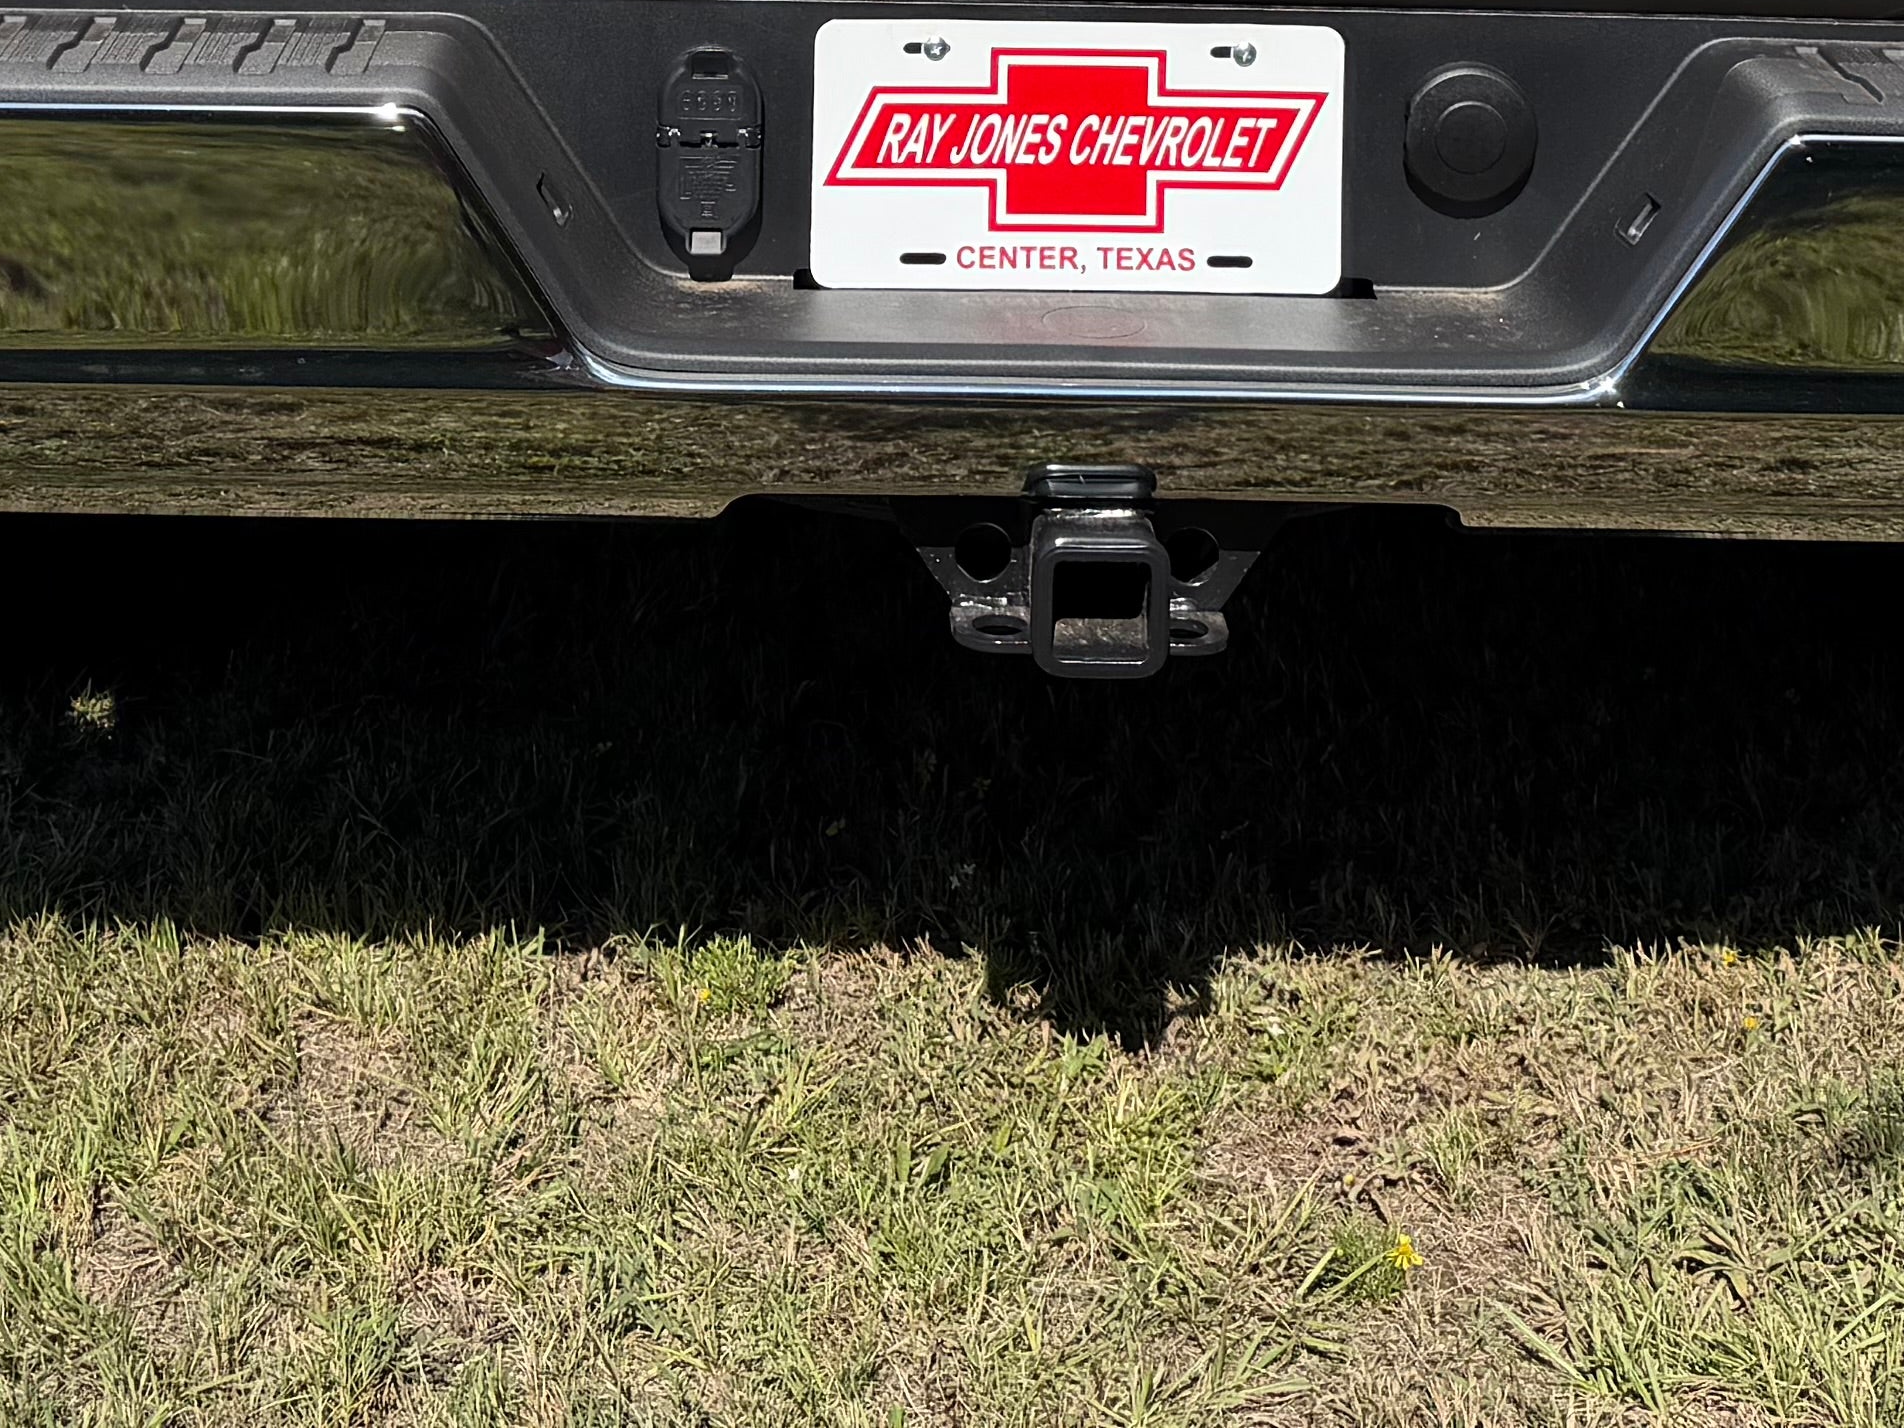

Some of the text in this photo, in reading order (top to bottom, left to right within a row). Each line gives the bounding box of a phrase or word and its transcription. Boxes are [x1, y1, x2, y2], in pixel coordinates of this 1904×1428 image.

[876, 113, 1278, 167] RAY JONES CHEVROLET
[956, 246, 1196, 274] CENTER, TEXAS
